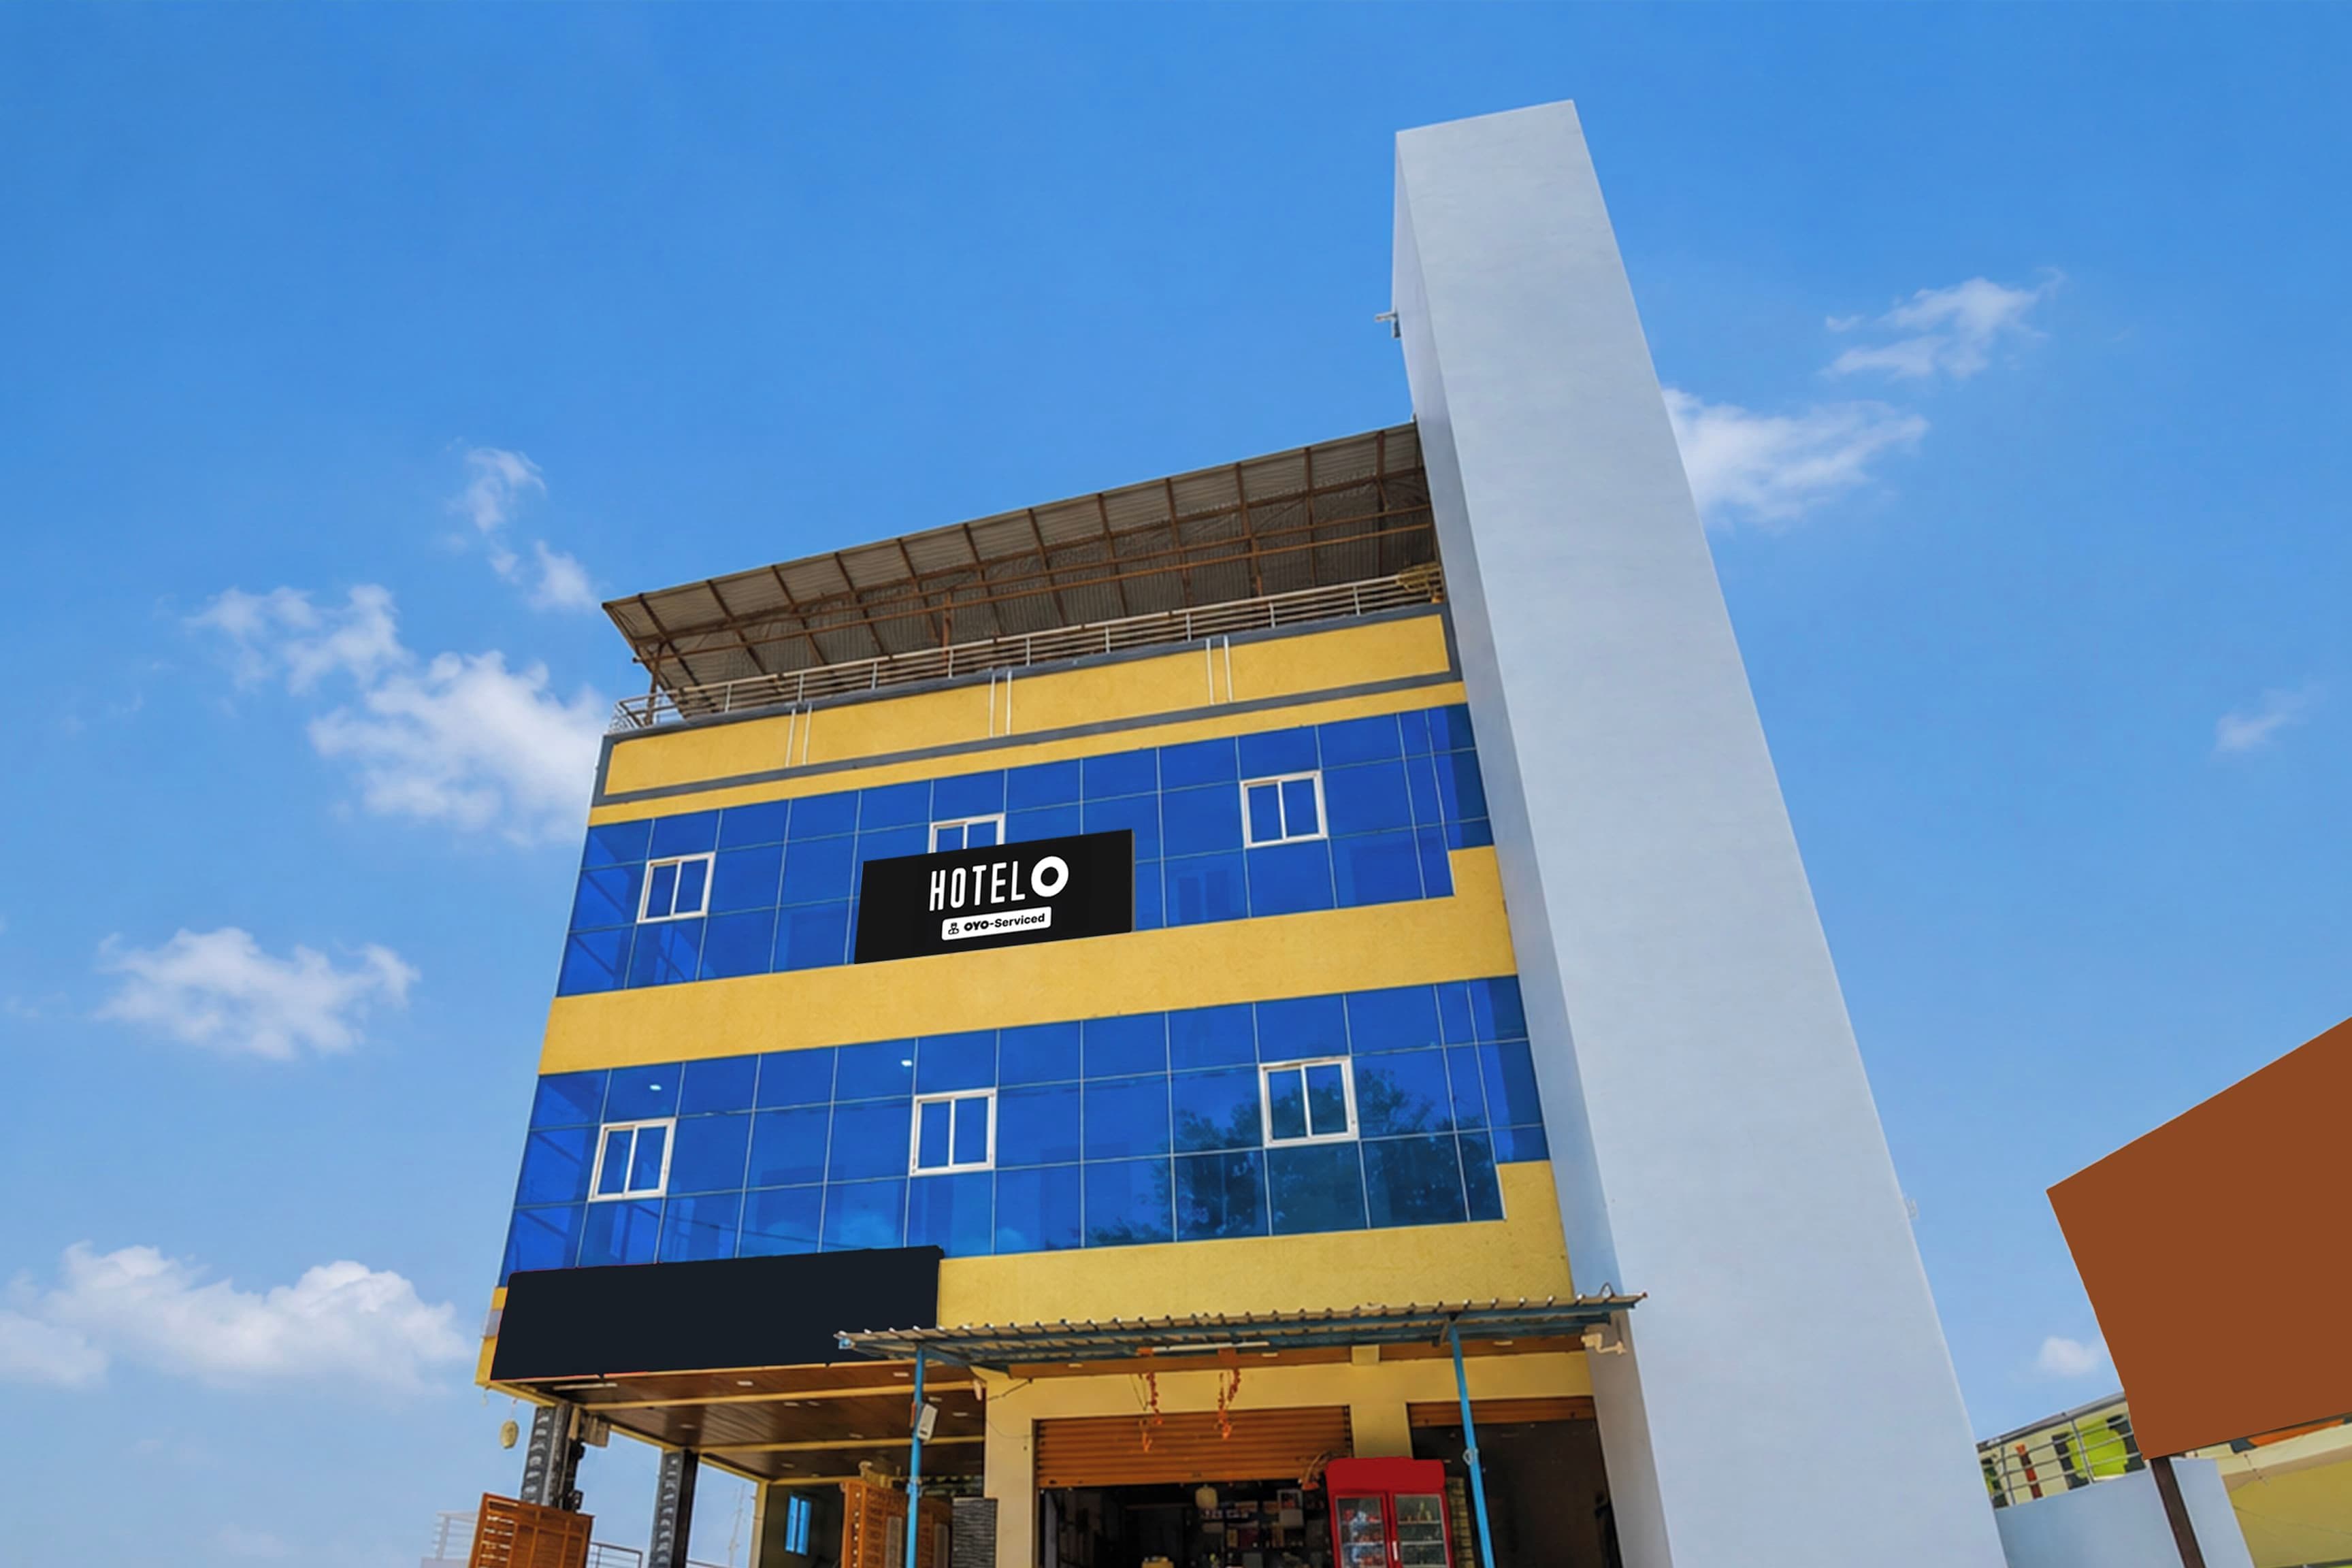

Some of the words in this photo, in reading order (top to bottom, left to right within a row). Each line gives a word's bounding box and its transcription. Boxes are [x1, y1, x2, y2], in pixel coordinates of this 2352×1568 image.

[929, 861, 1026, 911] HOTEL
[1031, 855, 1069, 897] O
[964, 913, 1045, 932] OYO-Serviced
